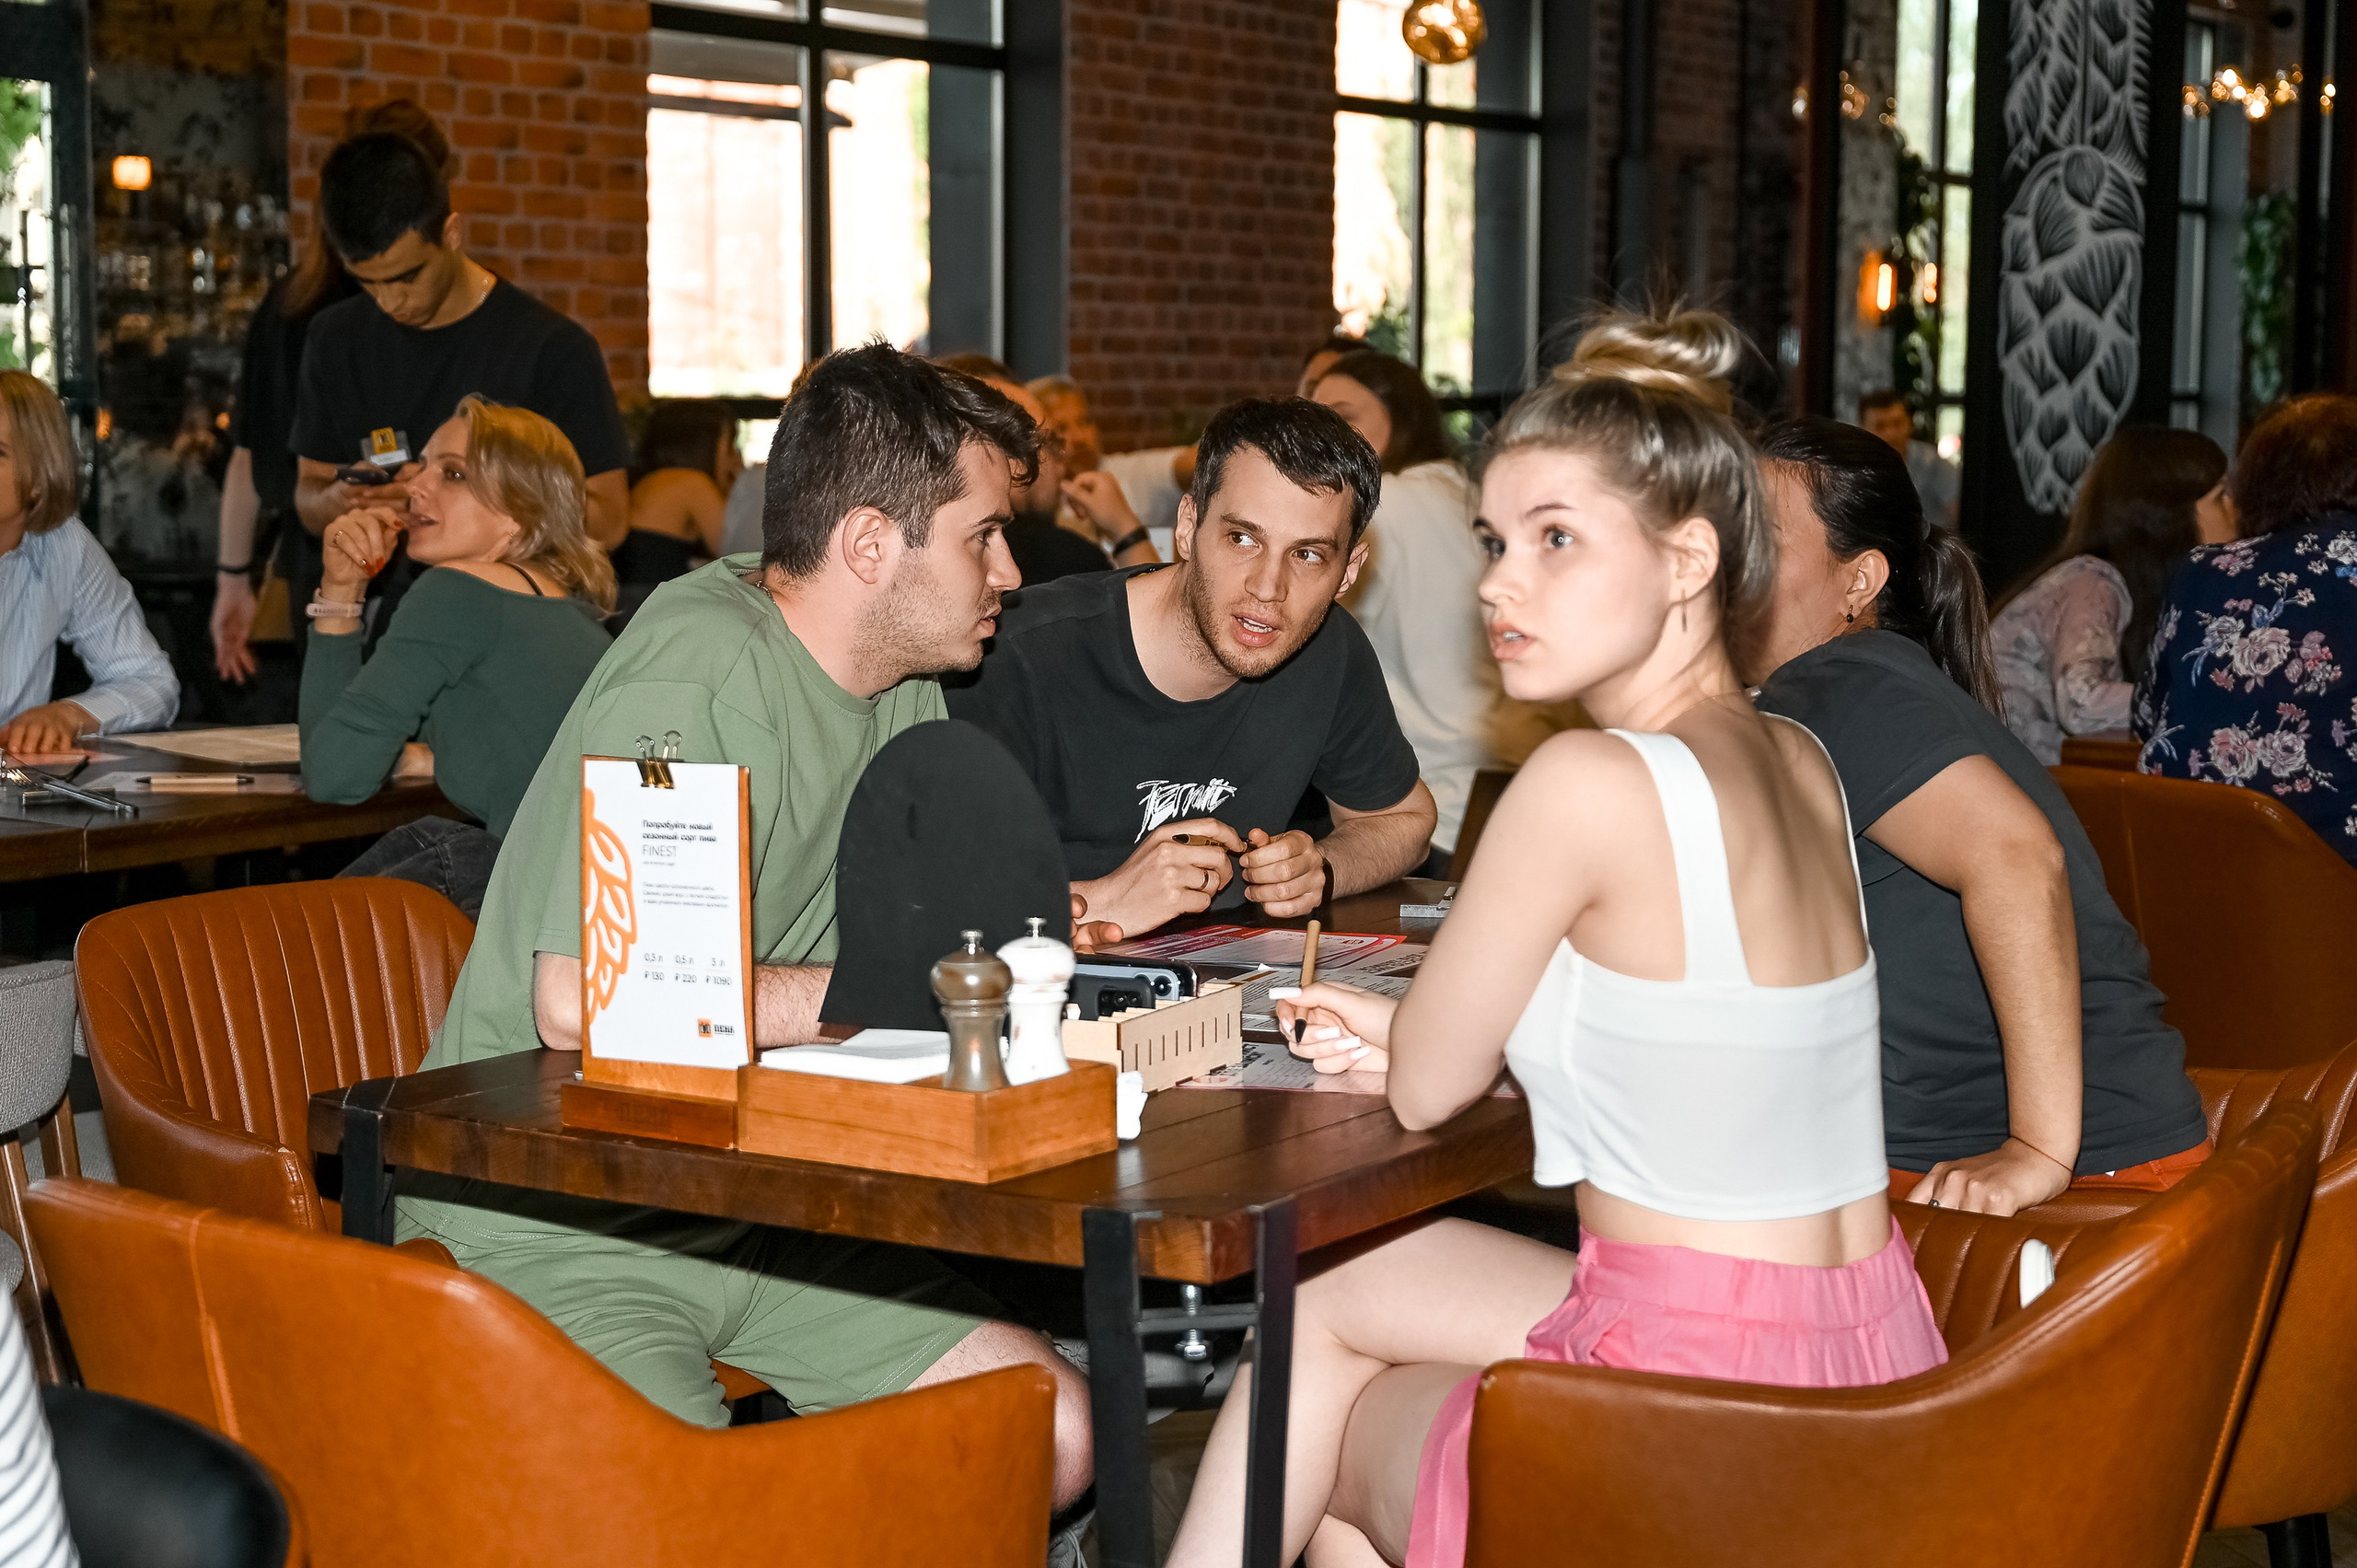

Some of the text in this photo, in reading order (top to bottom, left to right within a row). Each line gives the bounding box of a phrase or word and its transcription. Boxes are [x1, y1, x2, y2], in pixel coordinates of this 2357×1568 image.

[643, 819, 714, 830] Попробуйте новый
[643, 832, 679, 841] сезонный
[680, 834, 696, 842] сорт
[643, 844, 678, 857] FINEST
[644, 952, 656, 963] 0,3
[675, 955, 687, 965] 0,5
[651, 971, 665, 981] 130
[682, 973, 697, 983] 220
[713, 976, 732, 986] 1090
